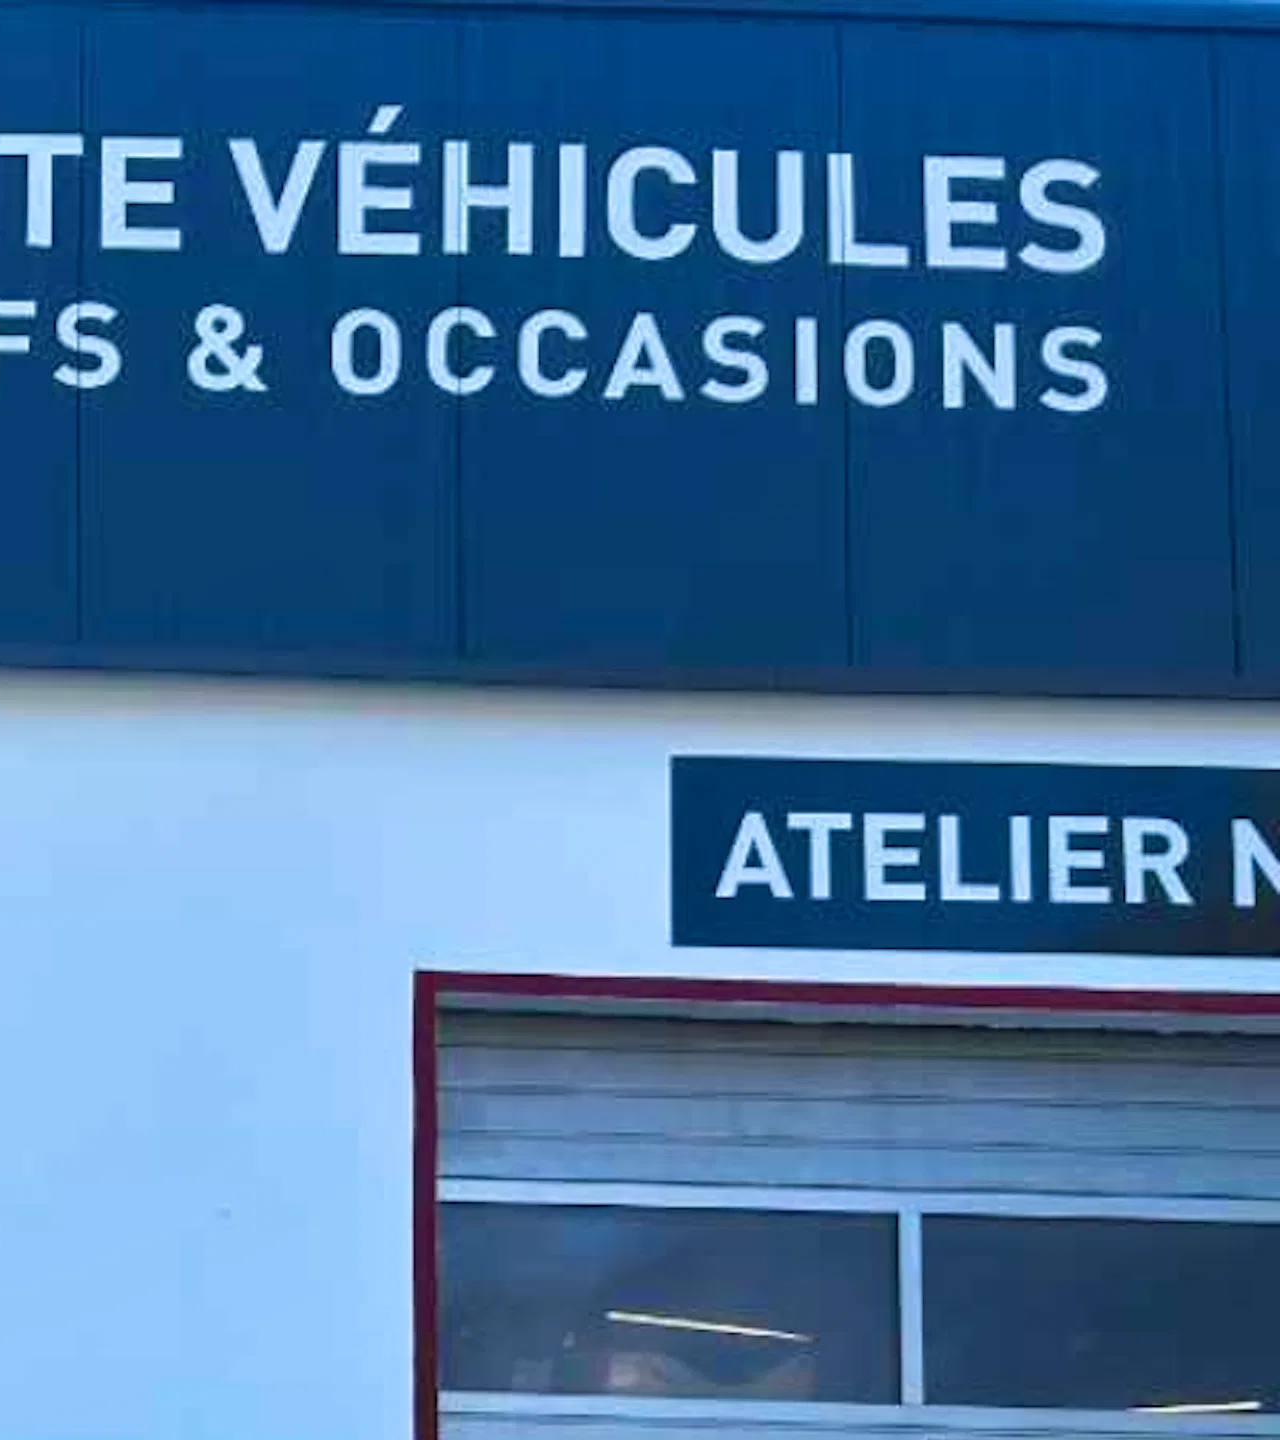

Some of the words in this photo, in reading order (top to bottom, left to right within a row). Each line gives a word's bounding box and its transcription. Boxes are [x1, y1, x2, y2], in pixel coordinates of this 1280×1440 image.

[229, 105, 1105, 272] VÉHICULES
[188, 304, 267, 392] &
[331, 307, 1108, 412] OCCASIONS
[715, 812, 1193, 904] ATELIER
